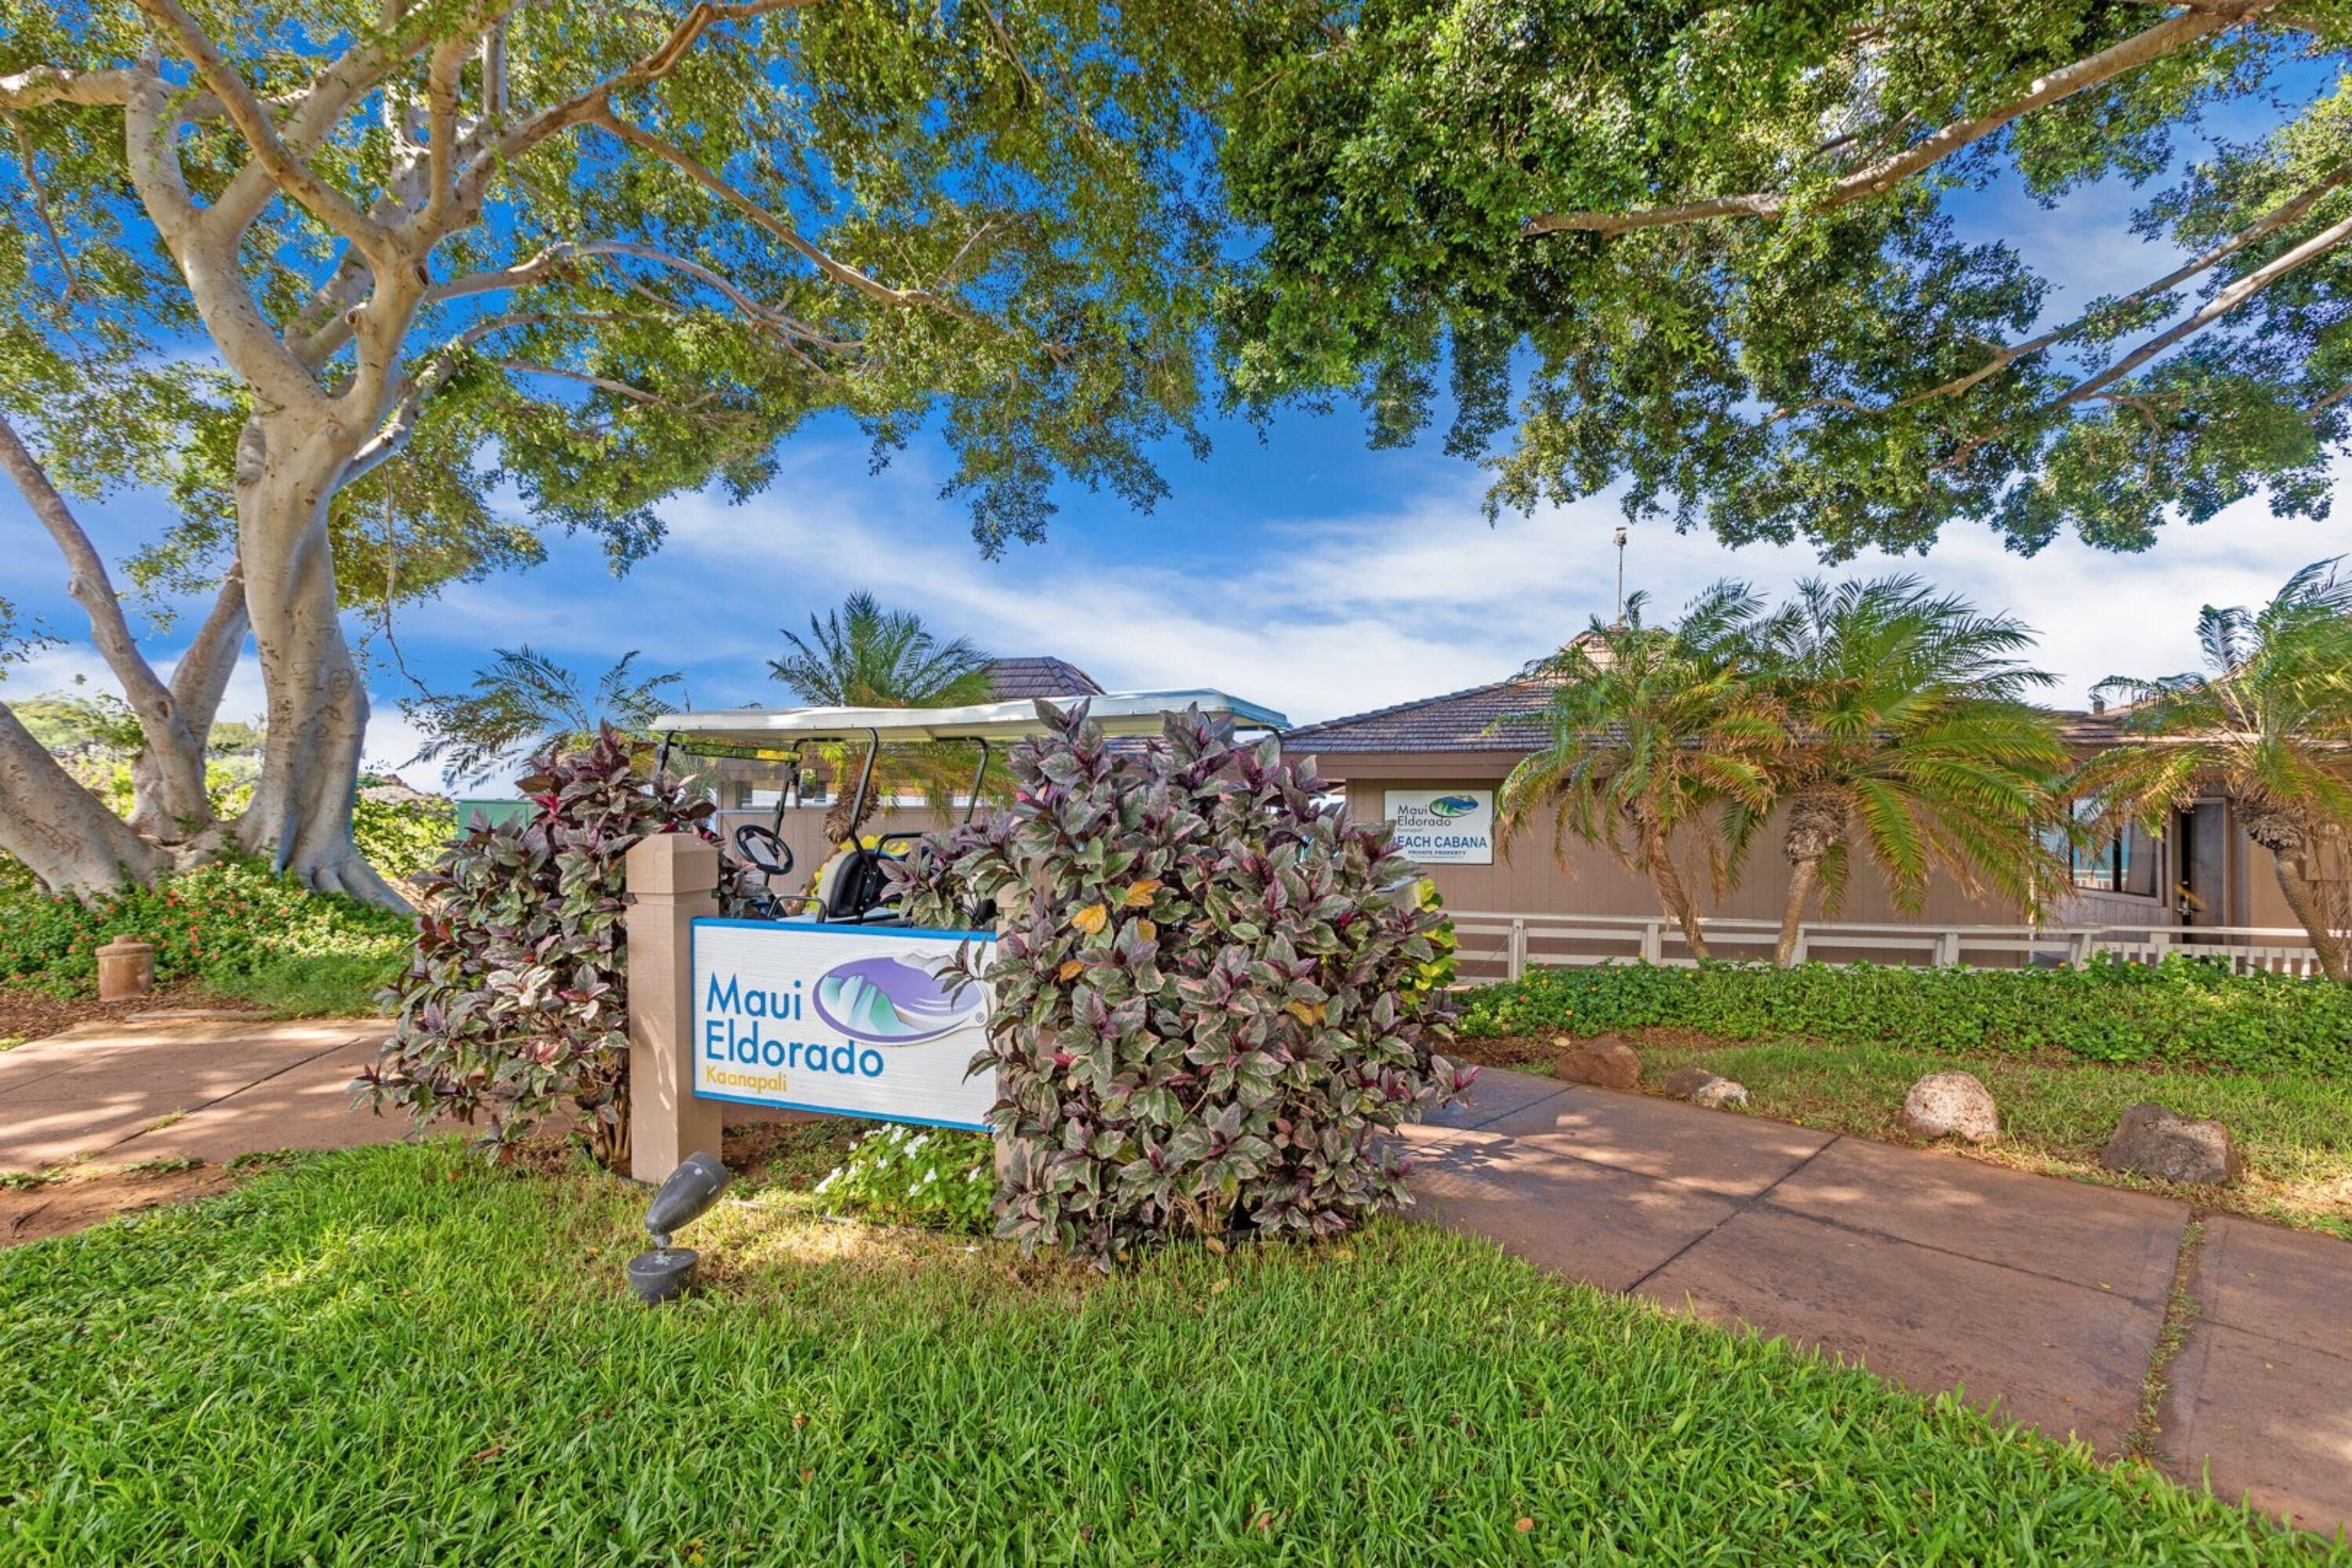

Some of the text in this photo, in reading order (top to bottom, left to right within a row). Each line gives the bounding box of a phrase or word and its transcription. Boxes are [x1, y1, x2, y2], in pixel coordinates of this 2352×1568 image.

[1398, 804, 1428, 815] Maui
[1397, 815, 1451, 826] Eldorado
[1434, 836, 1487, 848] CABANA
[706, 972, 801, 1020] Maui
[706, 1018, 884, 1077] Eldorado
[706, 1065, 787, 1094] Kaanapali
